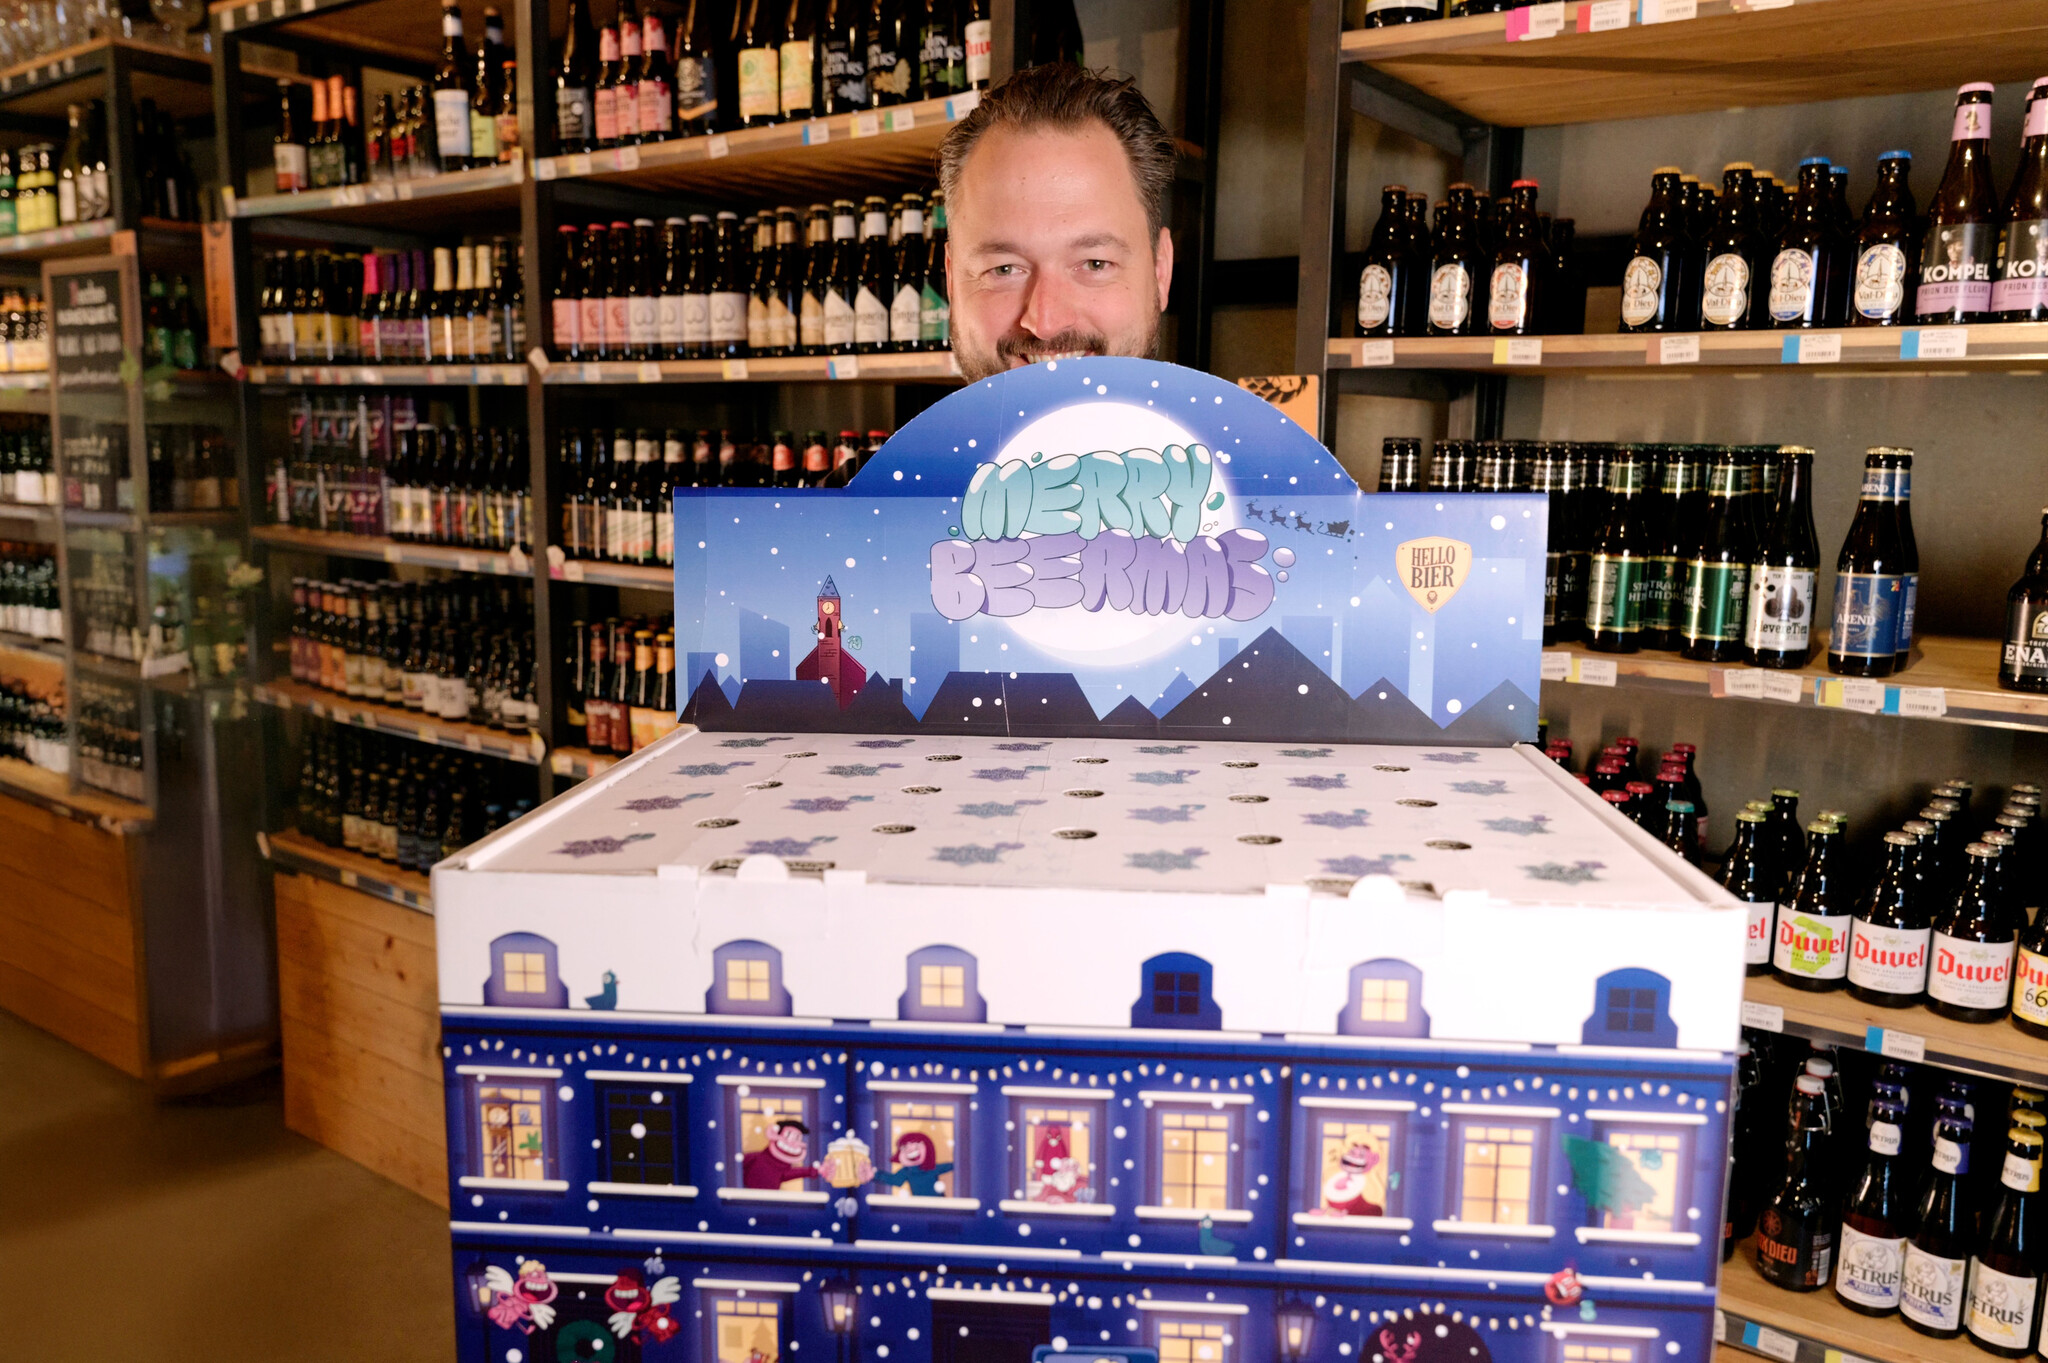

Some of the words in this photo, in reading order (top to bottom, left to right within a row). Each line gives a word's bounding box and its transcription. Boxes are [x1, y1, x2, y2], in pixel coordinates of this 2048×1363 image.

[1923, 264, 1990, 283] KOMPEL
[960, 443, 1213, 544] MERRY
[1411, 545, 1455, 567] HELLO
[929, 527, 1275, 622] BEERMAS
[1410, 565, 1455, 589] BIER
[1836, 612, 1877, 627] AREND
[2004, 644, 2048, 664] ENA
[1780, 919, 1847, 954] Duvel
[1854, 932, 1925, 969] Duvel
[1937, 947, 2010, 983] Duvel
[1768, 1239, 1798, 1265] DIEU
[644, 1256, 666, 1275] 16
[1841, 1258, 1900, 1288] PETRUS
